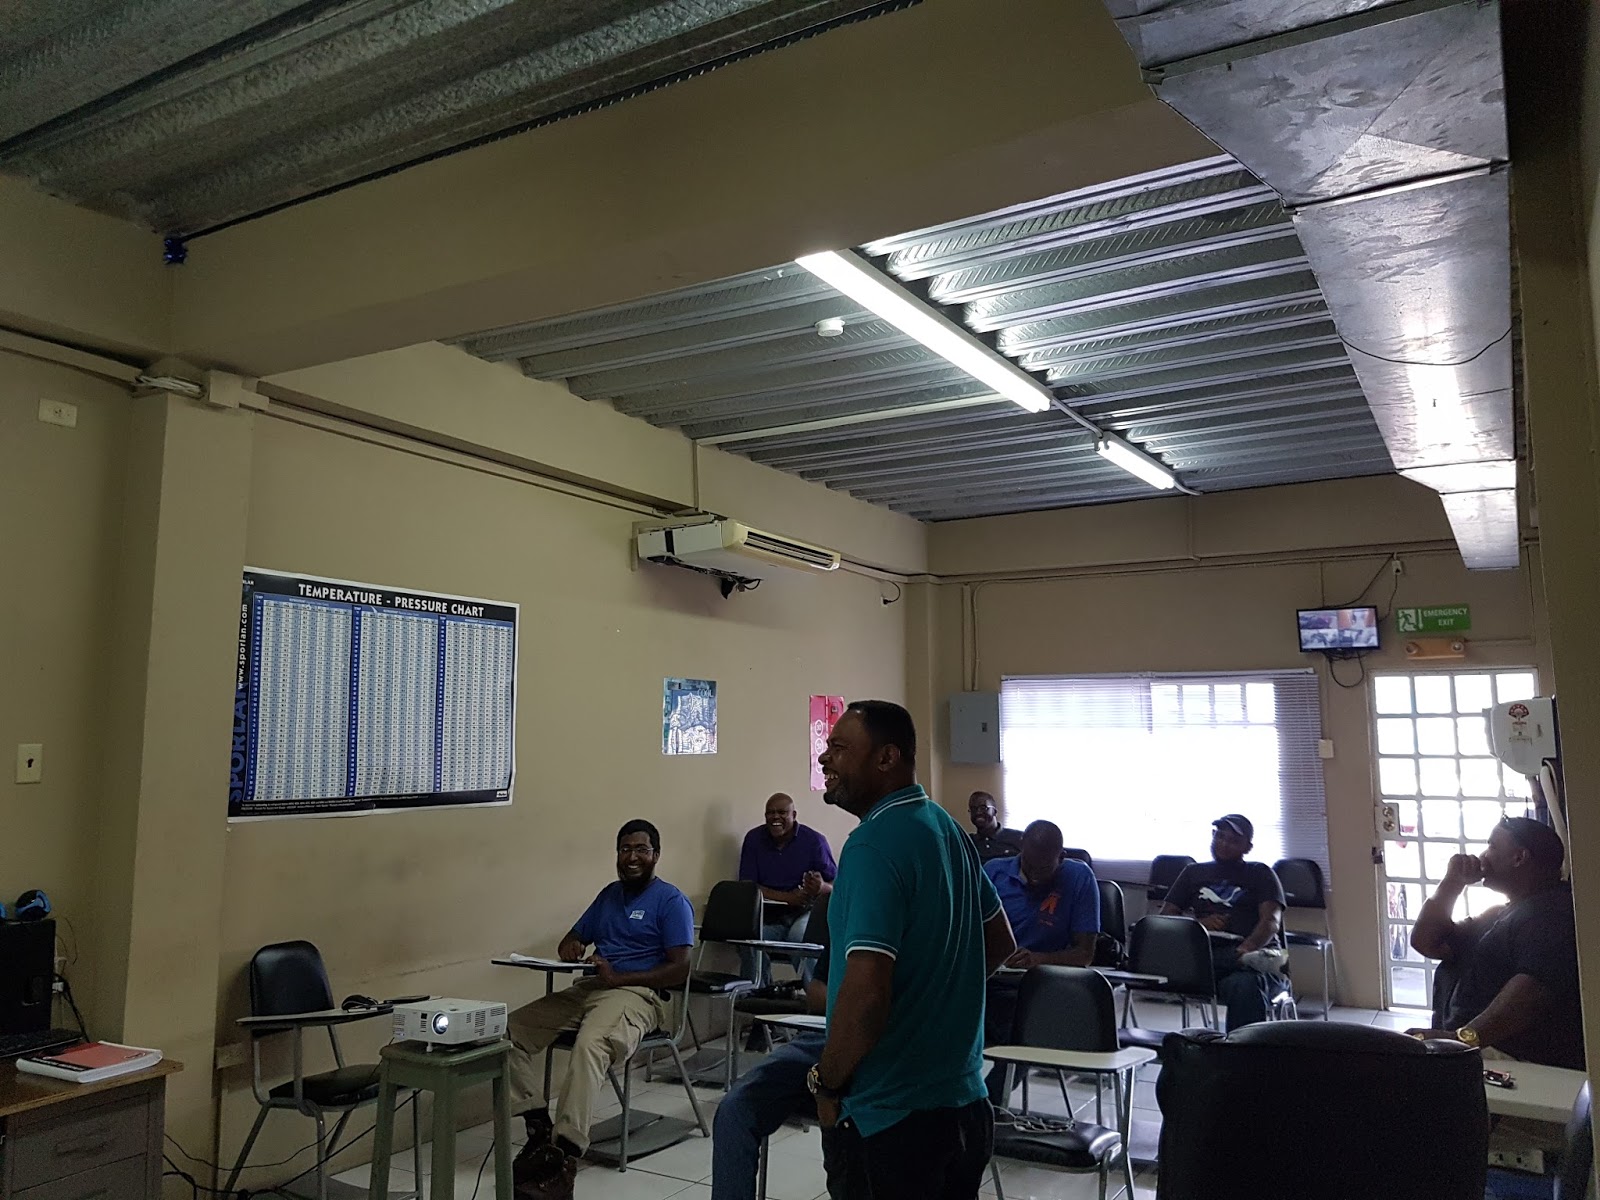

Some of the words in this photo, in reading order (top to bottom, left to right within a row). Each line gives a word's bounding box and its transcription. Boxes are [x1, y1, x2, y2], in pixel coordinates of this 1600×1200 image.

[298, 583, 382, 605] TEMPERATURE
[395, 597, 448, 613] PRESSURE
[451, 604, 484, 617] CHART
[1423, 608, 1467, 617] EMERGENCY
[237, 604, 247, 690] www.sporlan.com
